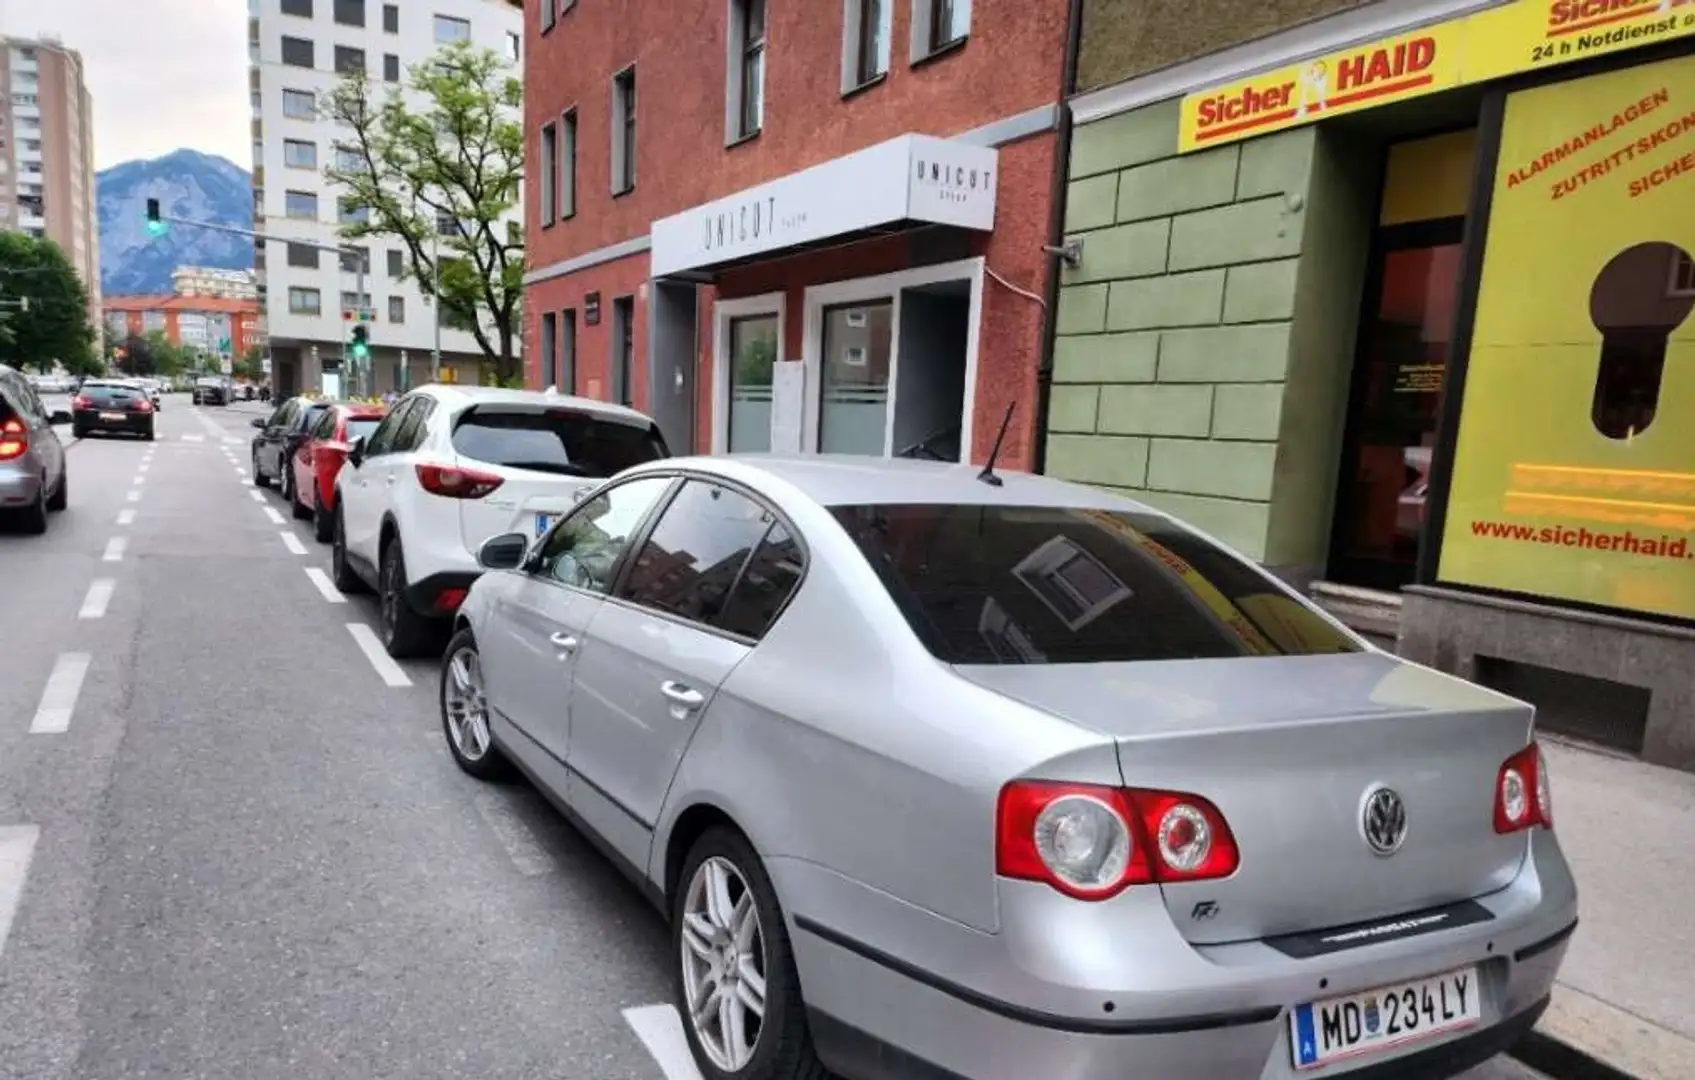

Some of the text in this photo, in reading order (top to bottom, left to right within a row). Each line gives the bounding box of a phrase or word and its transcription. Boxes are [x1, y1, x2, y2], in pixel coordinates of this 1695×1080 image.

[1531, 41, 1554, 62] 24
[1560, 41, 1571, 55] h
[1577, 15, 1678, 51] Notdienst
[1197, 41, 1436, 127] Sicher HAID
[1507, 86, 1669, 190] ALARMANLAGEN
[917, 159, 991, 191] UNICUT
[705, 196, 775, 251] UNICUT
[1321, 1001, 1362, 1051] MD
